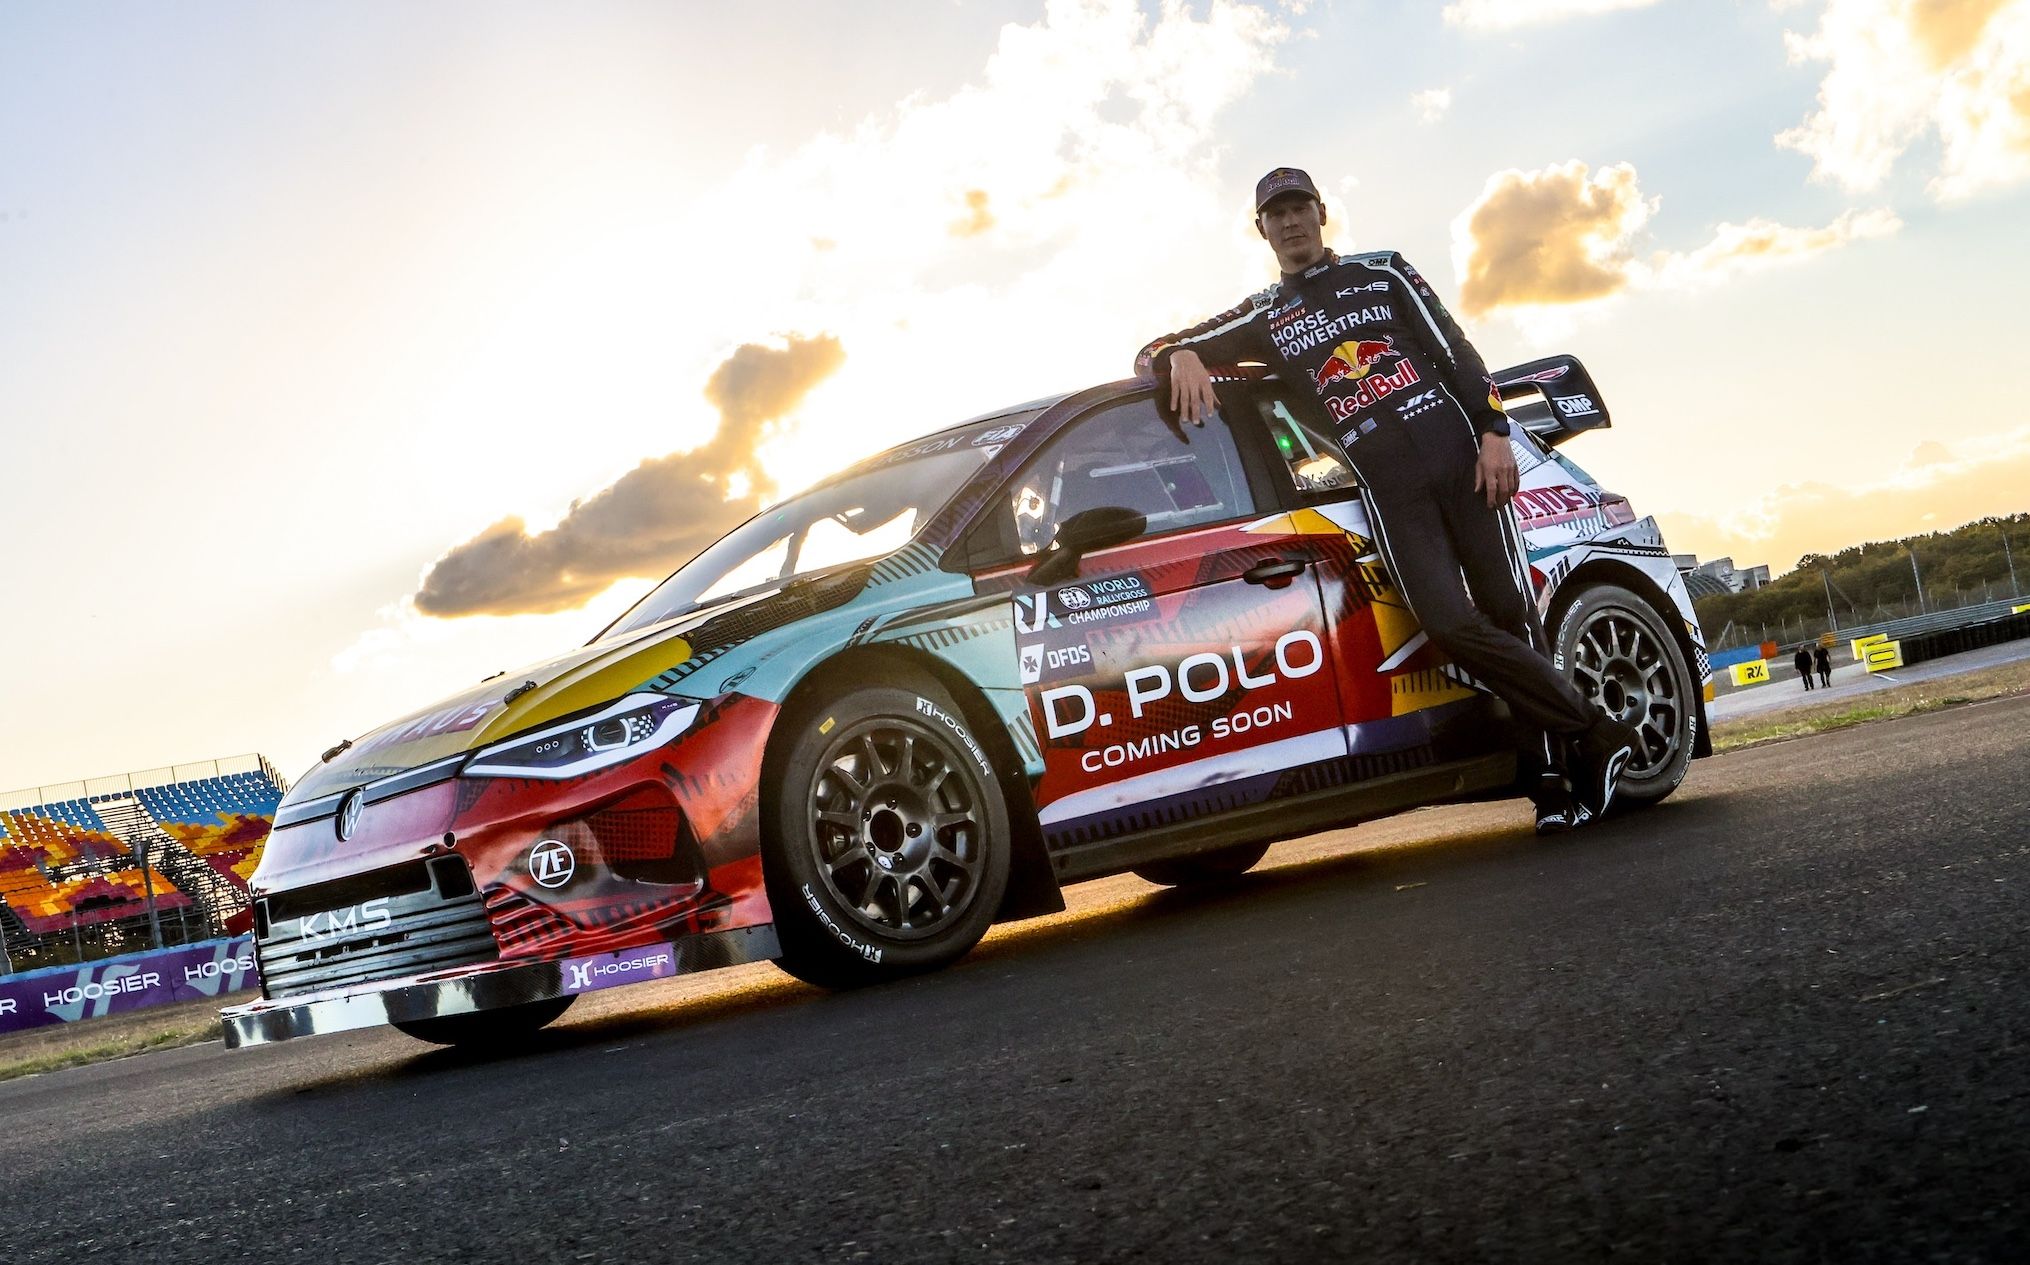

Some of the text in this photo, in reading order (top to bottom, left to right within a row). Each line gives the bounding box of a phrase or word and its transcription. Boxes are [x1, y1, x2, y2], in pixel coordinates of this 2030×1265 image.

[1367, 258, 1389, 267] OMP
[1336, 281, 1389, 298] KMS
[1269, 307, 1307, 330] BAUHAUS
[1271, 308, 1329, 347] HORSE
[1280, 306, 1393, 360] POWERTRAIN
[1325, 357, 1420, 424] Red Bull
[1557, 397, 1594, 414] OMP
[1341, 430, 1358, 447] OMP
[1058, 590, 1089, 605] FIA
[1087, 576, 1141, 595] WORLD
[1096, 587, 1148, 606] RALLYCROSS
[1068, 600, 1150, 625] CHAMPIONSHIP
[1046, 644, 1091, 669] DFDS
[1041, 629, 1323, 740] D. POLO
[1746, 665, 1764, 679] RX
[933, 703, 991, 776] HOOSIER
[1081, 701, 1293, 773] COMING SOON
[538, 852, 566, 881] ZF
[299, 897, 392, 943] KMS
[802, 883, 866, 956] HOOSIER
[594, 952, 670, 977] HOOSIER
[43, 970, 161, 1008] HOOSIER
